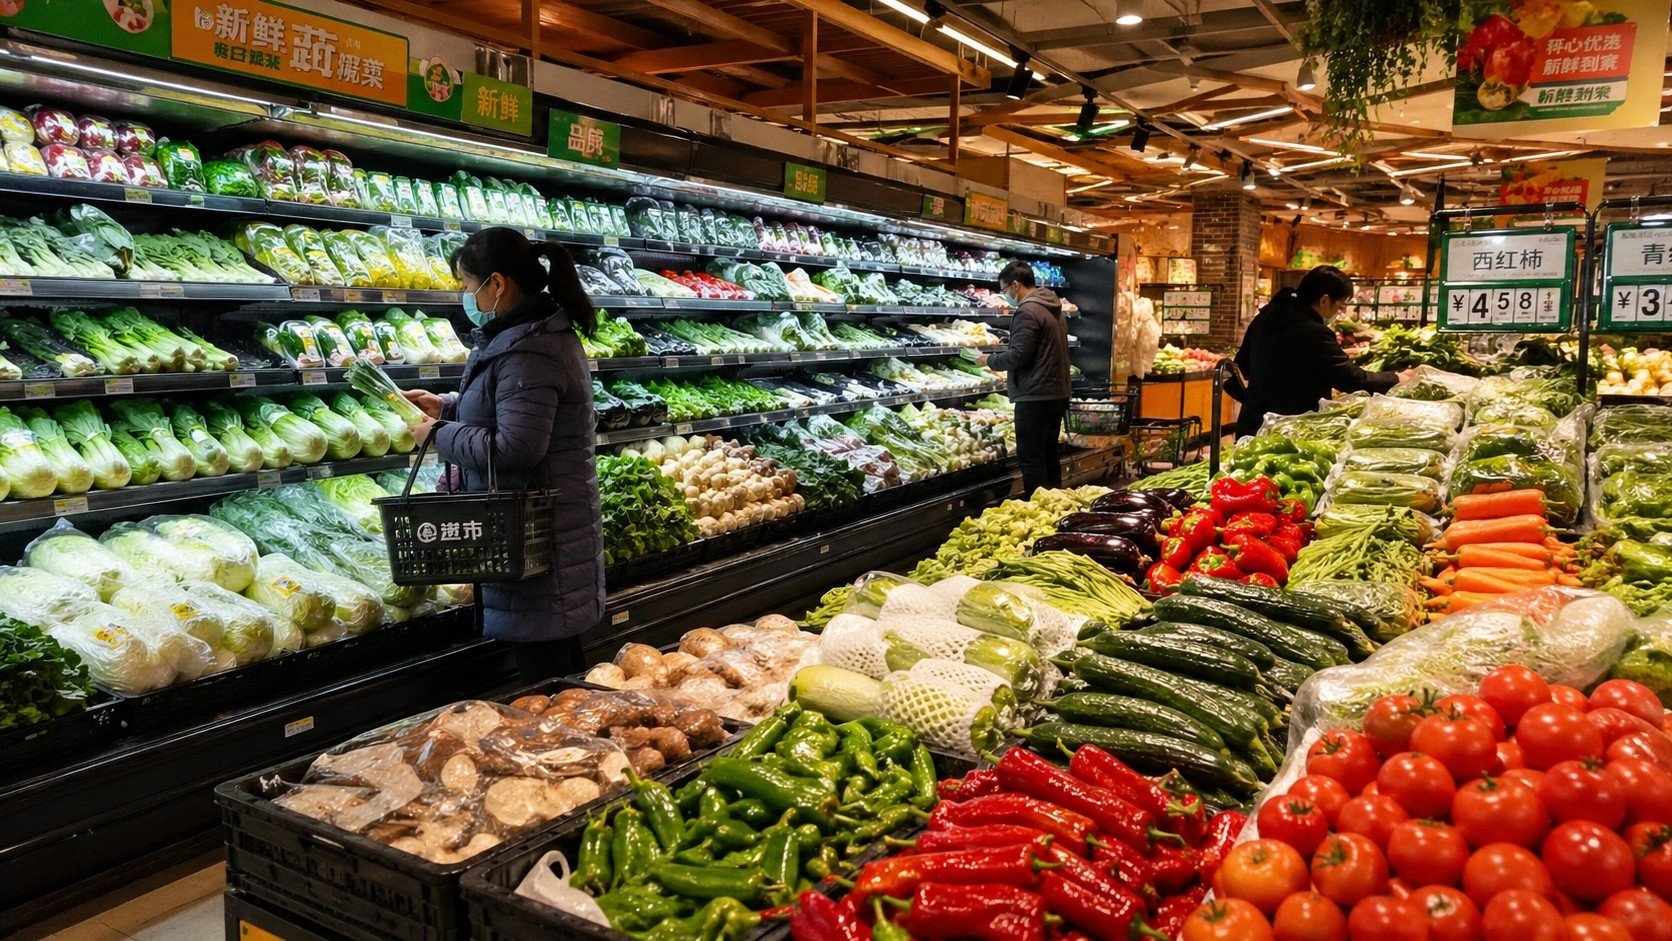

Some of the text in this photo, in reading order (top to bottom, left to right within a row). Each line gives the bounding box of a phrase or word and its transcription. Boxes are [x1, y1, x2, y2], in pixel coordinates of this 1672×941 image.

[477, 85, 519, 123] 新鲜
[1473, 248, 1544, 271] 西红柿
[1641, 243, 1672, 266] 青
